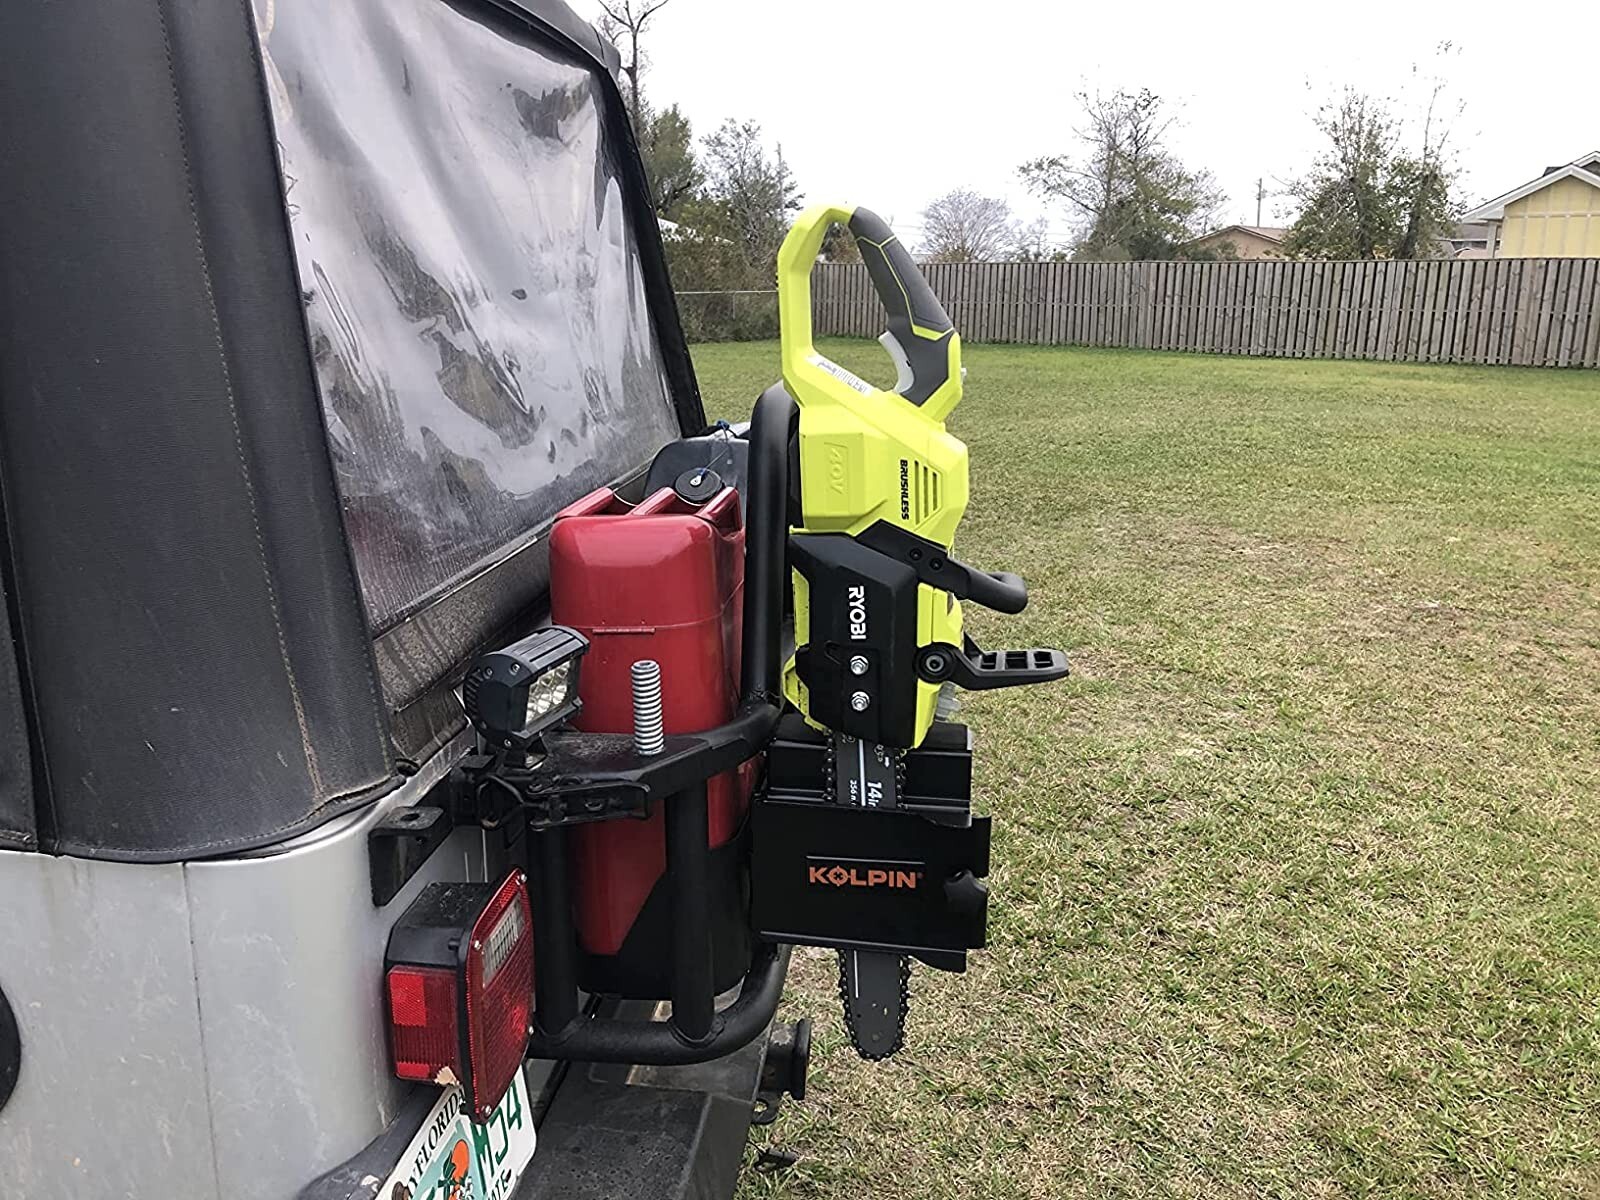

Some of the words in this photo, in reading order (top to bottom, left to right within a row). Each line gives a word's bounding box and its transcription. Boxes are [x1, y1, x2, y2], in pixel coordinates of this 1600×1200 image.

[900, 459, 909, 520] BRUSHLESS
[848, 585, 867, 640] RYOBI
[809, 865, 916, 888] KOLPIN
